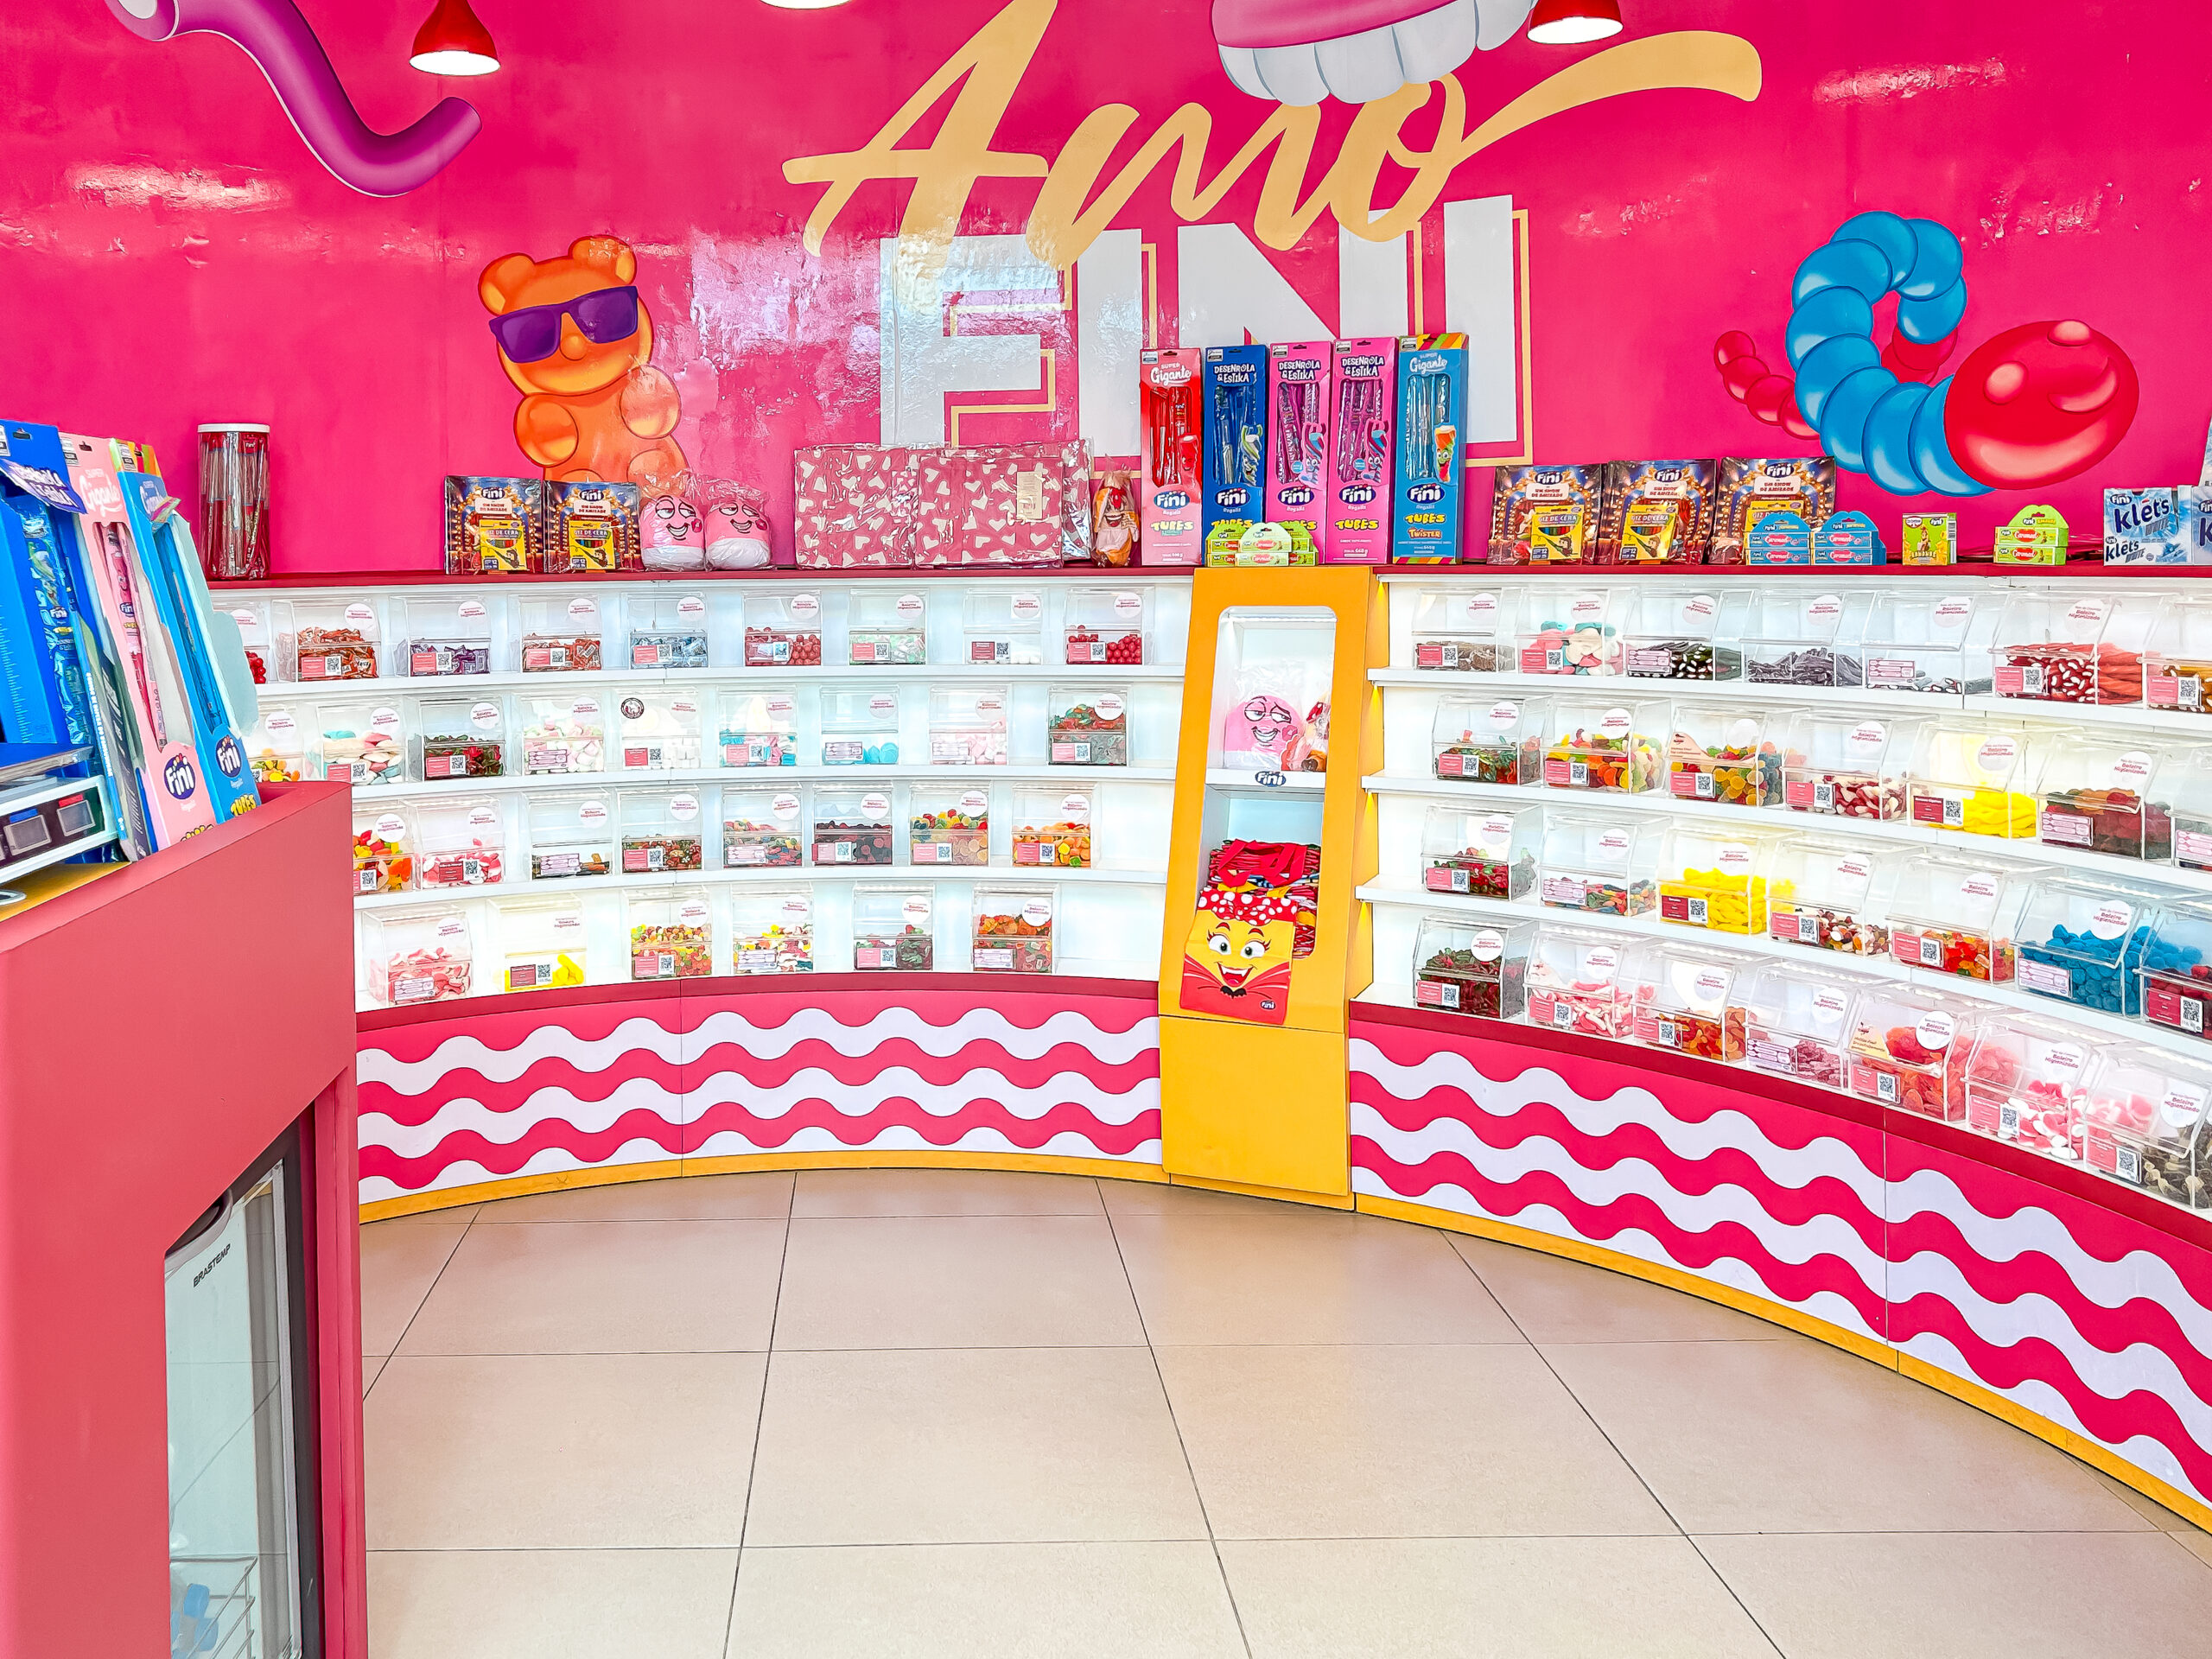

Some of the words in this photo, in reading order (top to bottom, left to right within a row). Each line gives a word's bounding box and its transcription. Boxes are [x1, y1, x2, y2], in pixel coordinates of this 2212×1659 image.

[782, 0, 1763, 270] Amo
[880, 194, 1518, 448] FINI
[1279, 359, 1320, 371] DESENROLA
[1342, 355, 1384, 366] DESENROLA
[1410, 355, 1448, 374] Gigante
[1214, 363, 1255, 373] DESENROLA
[1351, 366, 1379, 377] ESTIKA
[1150, 365, 1192, 386] Gigante
[1224, 373, 1249, 383] ESTIKA
[1288, 370, 1315, 380] ESTIKA
[1656, 469, 1680, 481] Fini
[1767, 464, 1791, 476] Fini
[1536, 472, 1560, 484] Fini
[482, 487, 503, 499] Fini
[581, 489, 601, 500] Fini
[1217, 487, 1247, 505] Fini
[1281, 487, 1311, 504] Fini
[1342, 486, 1372, 503] Fini
[1410, 485, 1441, 502] Fini
[1157, 491, 1187, 508] Fini
[2111, 494, 2131, 505] Fini
[1335, 518, 1379, 531] TUBES
[1405, 513, 1446, 524] TUBES
[1151, 520, 1194, 531] TUBES
[216, 739, 241, 774] Fini
[165, 755, 194, 796] Fini
[1257, 771, 1285, 785] Fini
[194, 1243, 231, 1288] BRASTEMP
